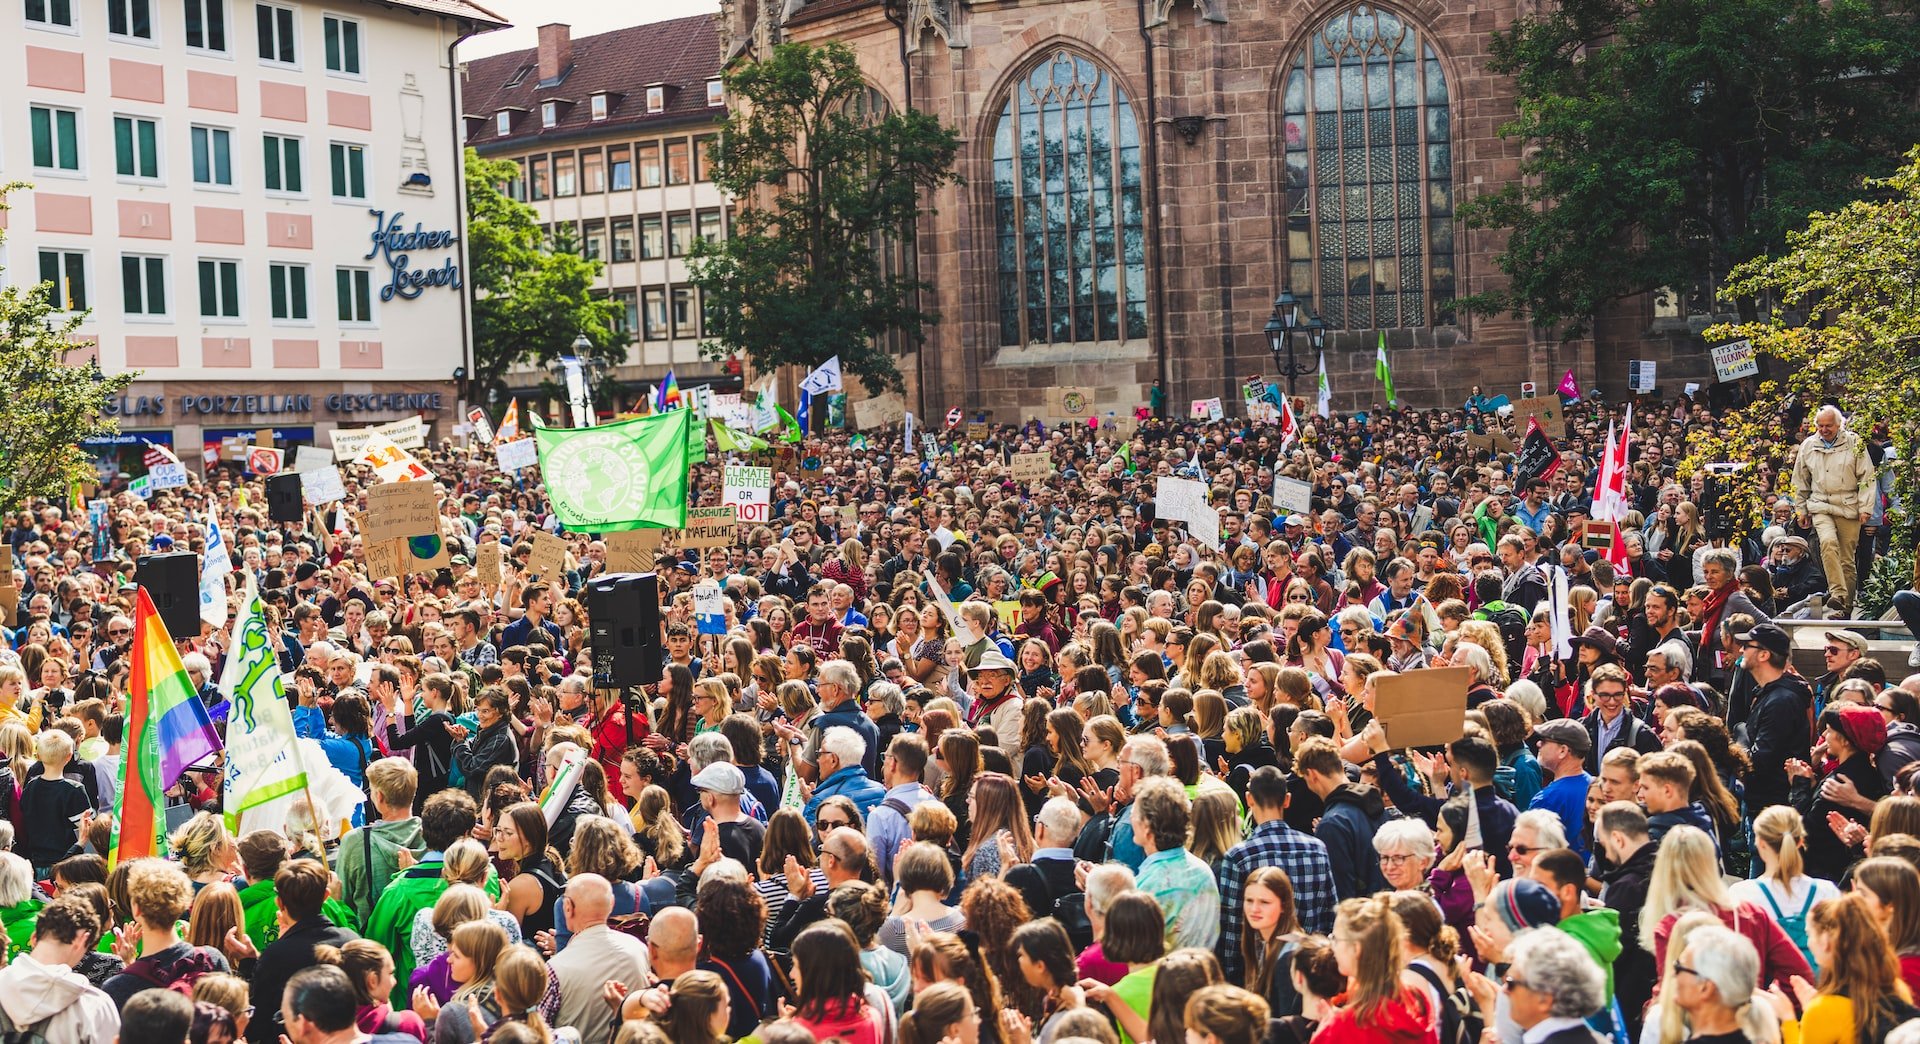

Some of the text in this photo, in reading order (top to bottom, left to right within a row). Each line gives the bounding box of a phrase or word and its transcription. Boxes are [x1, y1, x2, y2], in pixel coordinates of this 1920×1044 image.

[381, 254, 463, 302] Loesch
[103, 392, 442, 415] GLAS PORZELLAN GESCHENKE
[155, 466, 177, 477] OUR
[725, 467, 770, 479] CLIMATE
[152, 475, 186, 488] FUTURE
[725, 477, 770, 489] JUSTICE
[739, 490, 753, 501] OR
